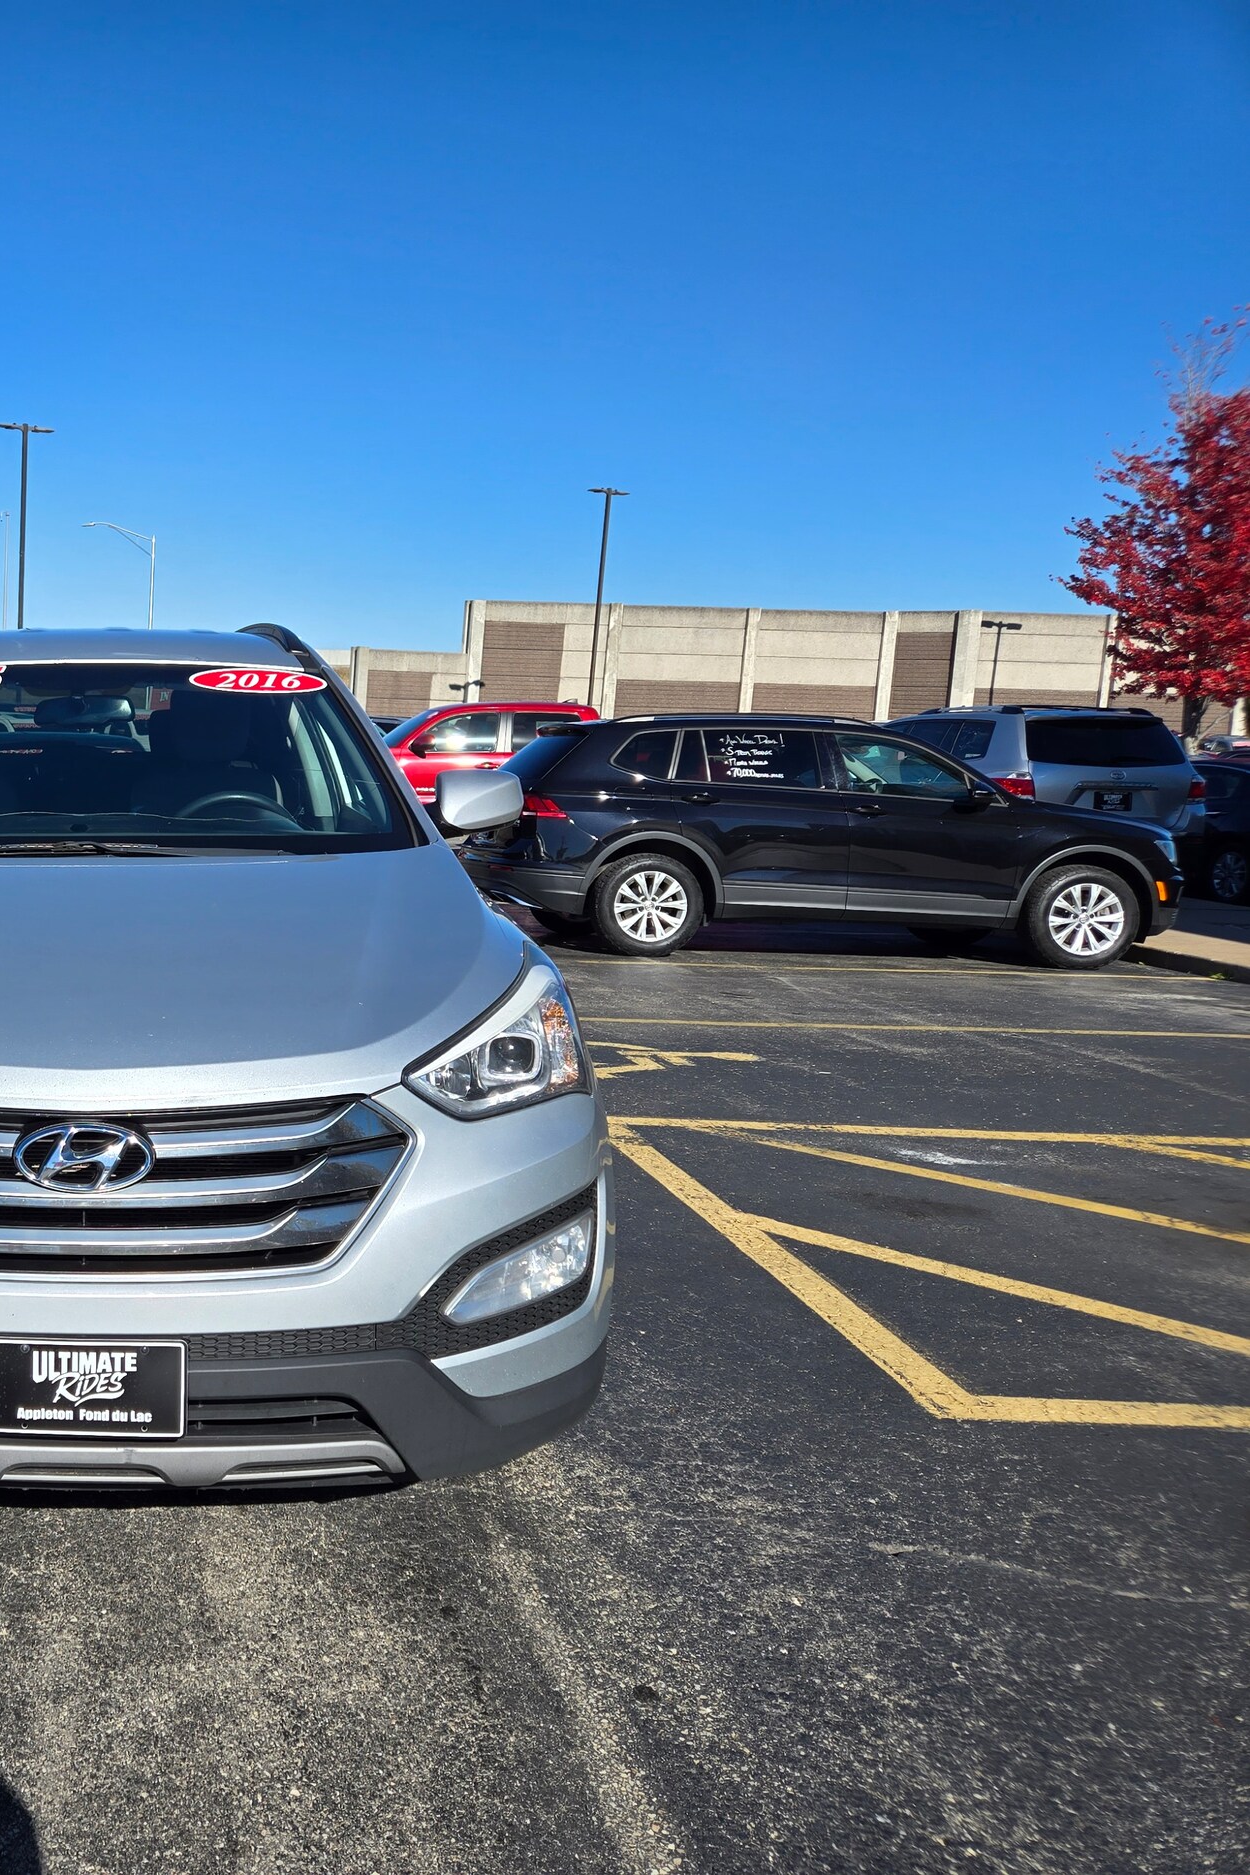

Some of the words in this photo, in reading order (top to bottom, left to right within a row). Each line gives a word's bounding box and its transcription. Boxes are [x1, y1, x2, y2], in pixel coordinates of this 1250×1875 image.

[215, 673, 302, 689] 2016
[32, 1350, 138, 1384] ULTIMATE
[52, 1371, 128, 1407] RIDES
[16, 1407, 74, 1421] Appleton
[79, 1408, 110, 1422] Fond
[111, 1410, 128, 1422] du
[130, 1410, 153, 1423] Lac
